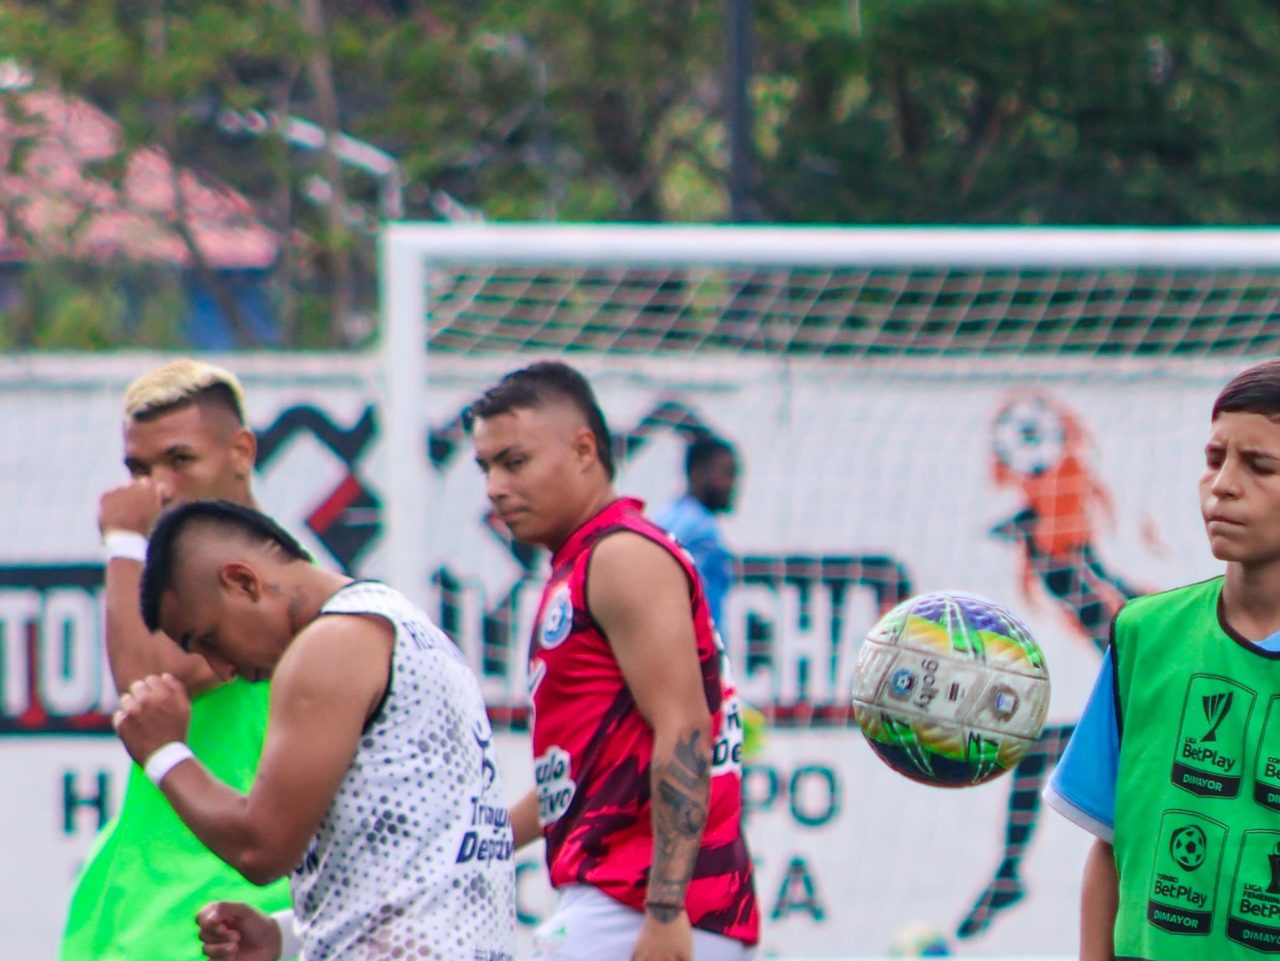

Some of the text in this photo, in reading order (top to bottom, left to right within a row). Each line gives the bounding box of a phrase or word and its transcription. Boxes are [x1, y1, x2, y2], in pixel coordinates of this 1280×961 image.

[1182, 743, 1236, 772] BetPlay
[1183, 773, 1223, 792] DIMAYOR
[1154, 881, 1207, 908] BetPlay
[1243, 883, 1264, 893] LIGA
[1153, 910, 1198, 928] DIMAYOR
